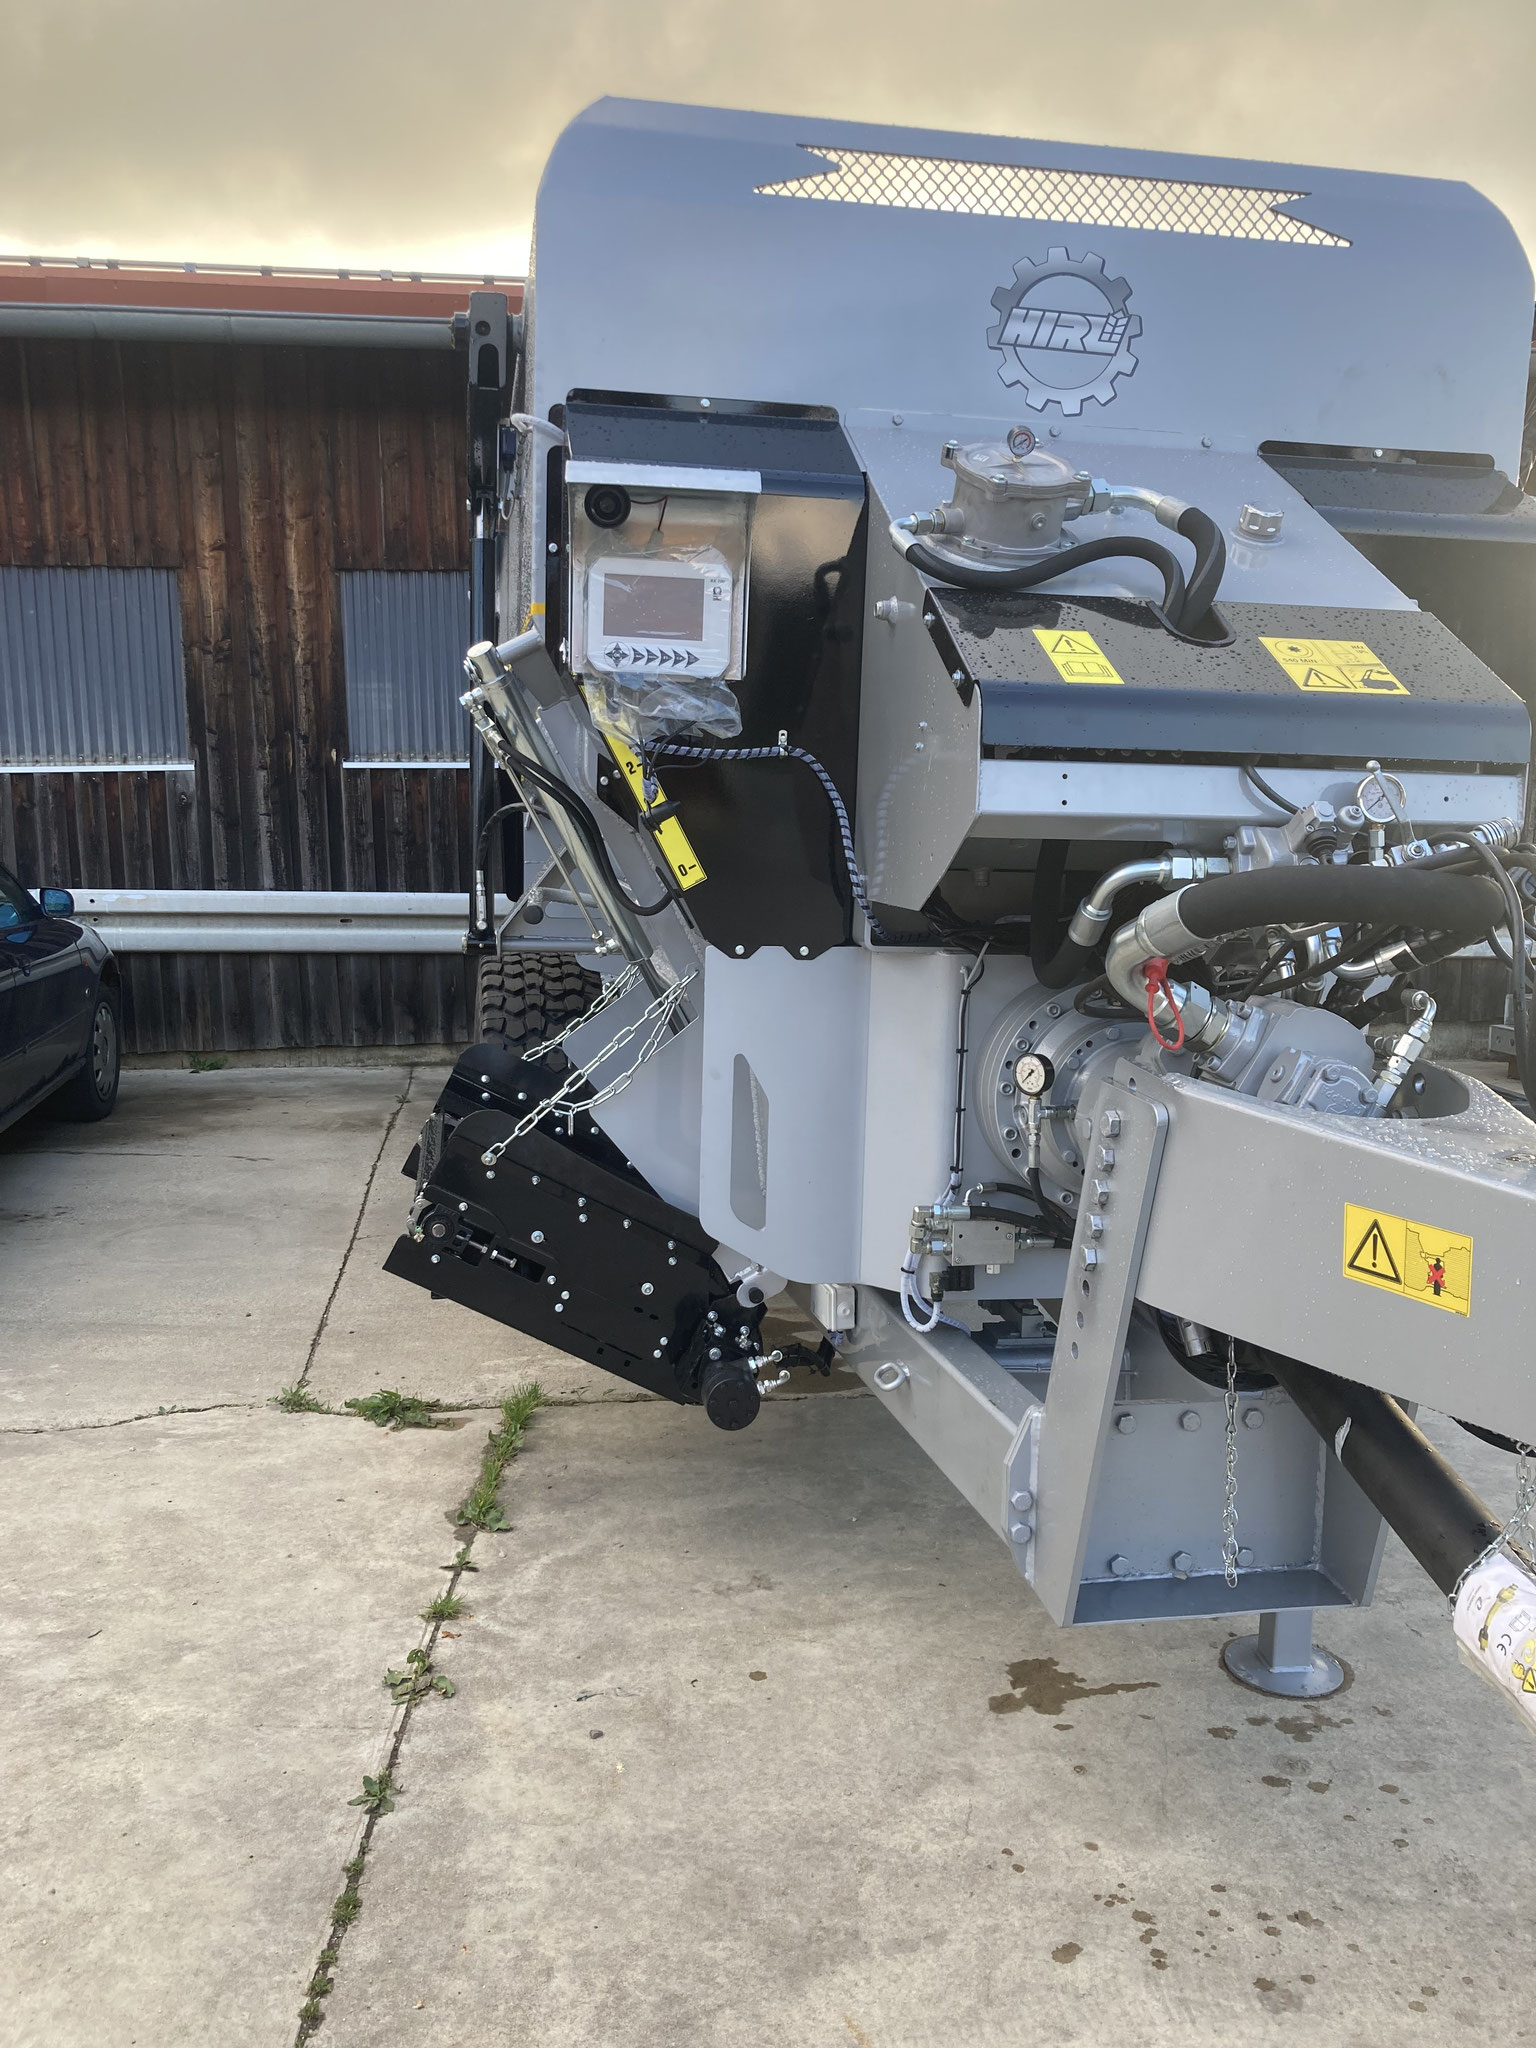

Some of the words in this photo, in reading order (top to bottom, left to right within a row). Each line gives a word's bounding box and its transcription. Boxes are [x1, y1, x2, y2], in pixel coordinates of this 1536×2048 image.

[998, 307, 1126, 357] HIRL
[626, 762, 637, 775] 2
[678, 864, 688, 877] 0
[1497, 1634, 1512, 1656] CE
